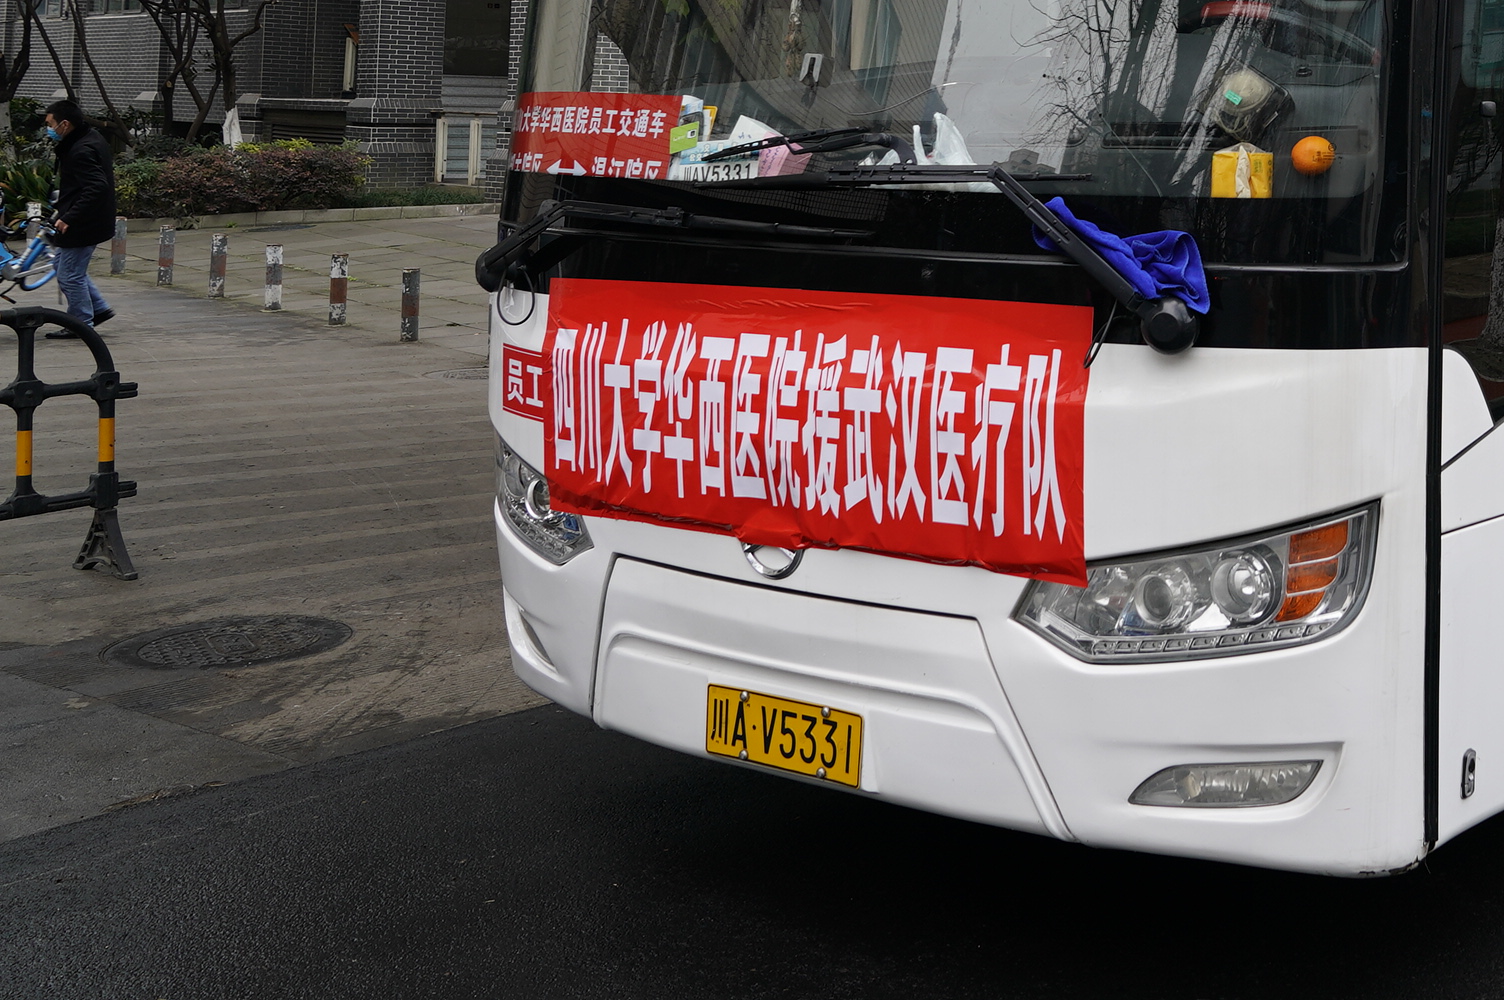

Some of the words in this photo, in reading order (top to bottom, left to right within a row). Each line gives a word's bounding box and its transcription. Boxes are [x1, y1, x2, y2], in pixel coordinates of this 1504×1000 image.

[507, 358, 544, 409] 员工
[551, 318, 1067, 545] 四川大学华西医院援武汉医疗队
